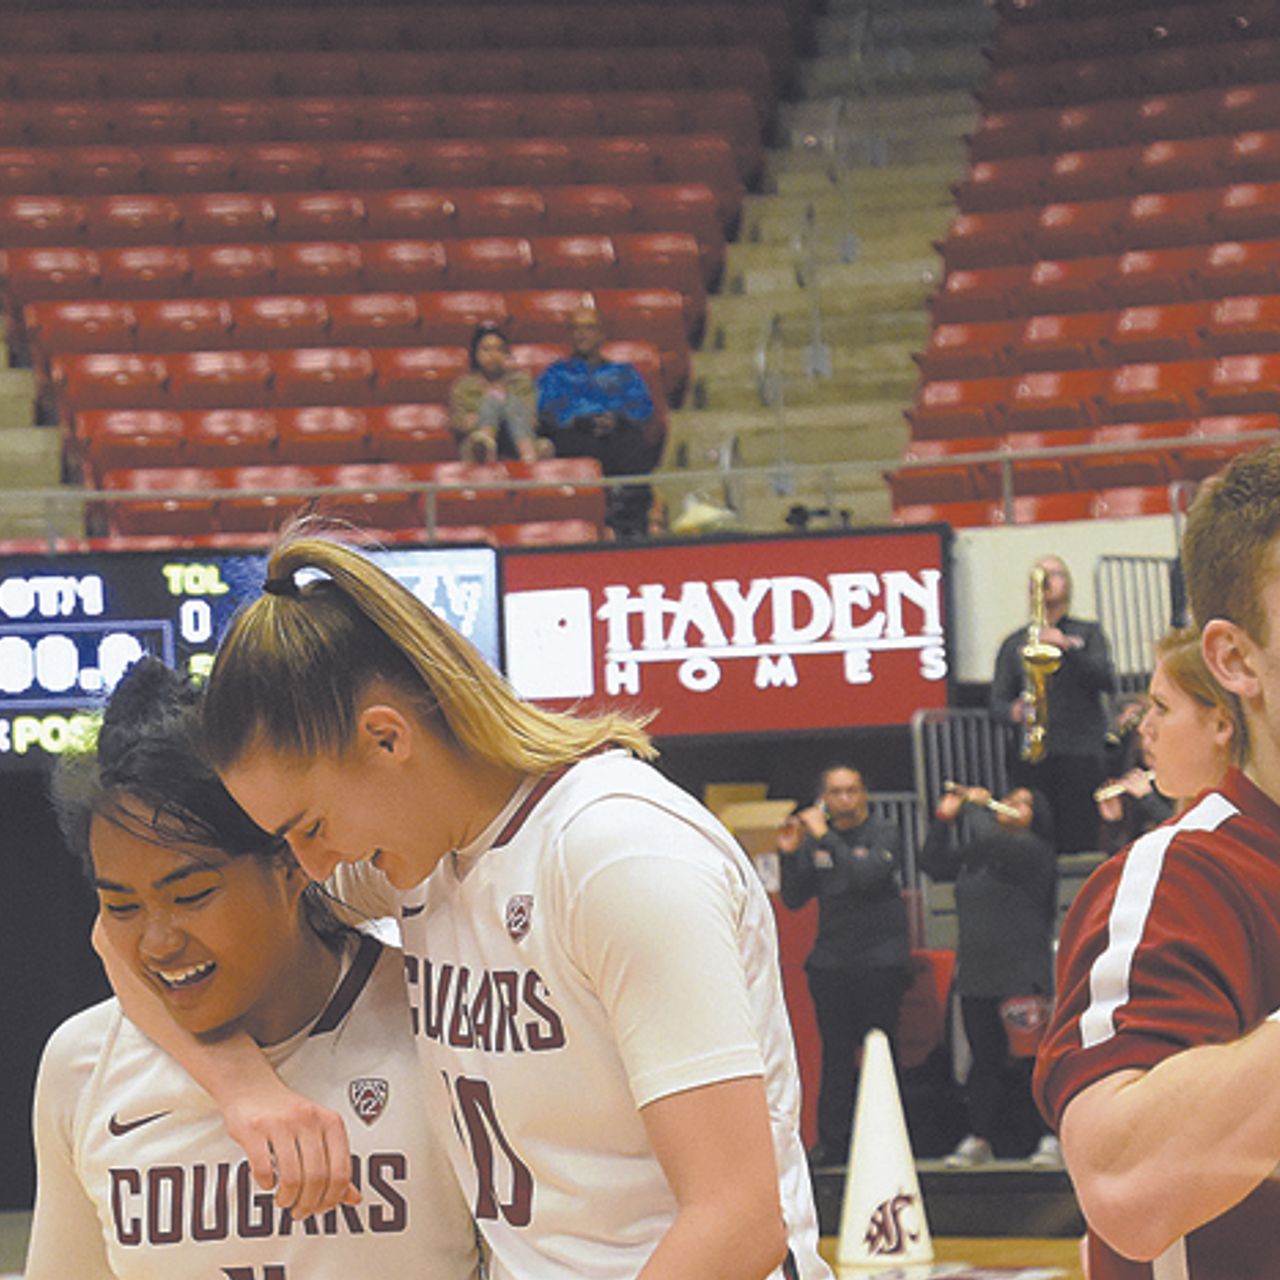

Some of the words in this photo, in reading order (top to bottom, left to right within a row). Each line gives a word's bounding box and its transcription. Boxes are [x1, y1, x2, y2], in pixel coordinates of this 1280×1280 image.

[162, 563, 230, 596] TOL
[179, 599, 212, 643] 0
[597, 569, 944, 652] HAYDEN
[604, 647, 948, 696] HOMES
